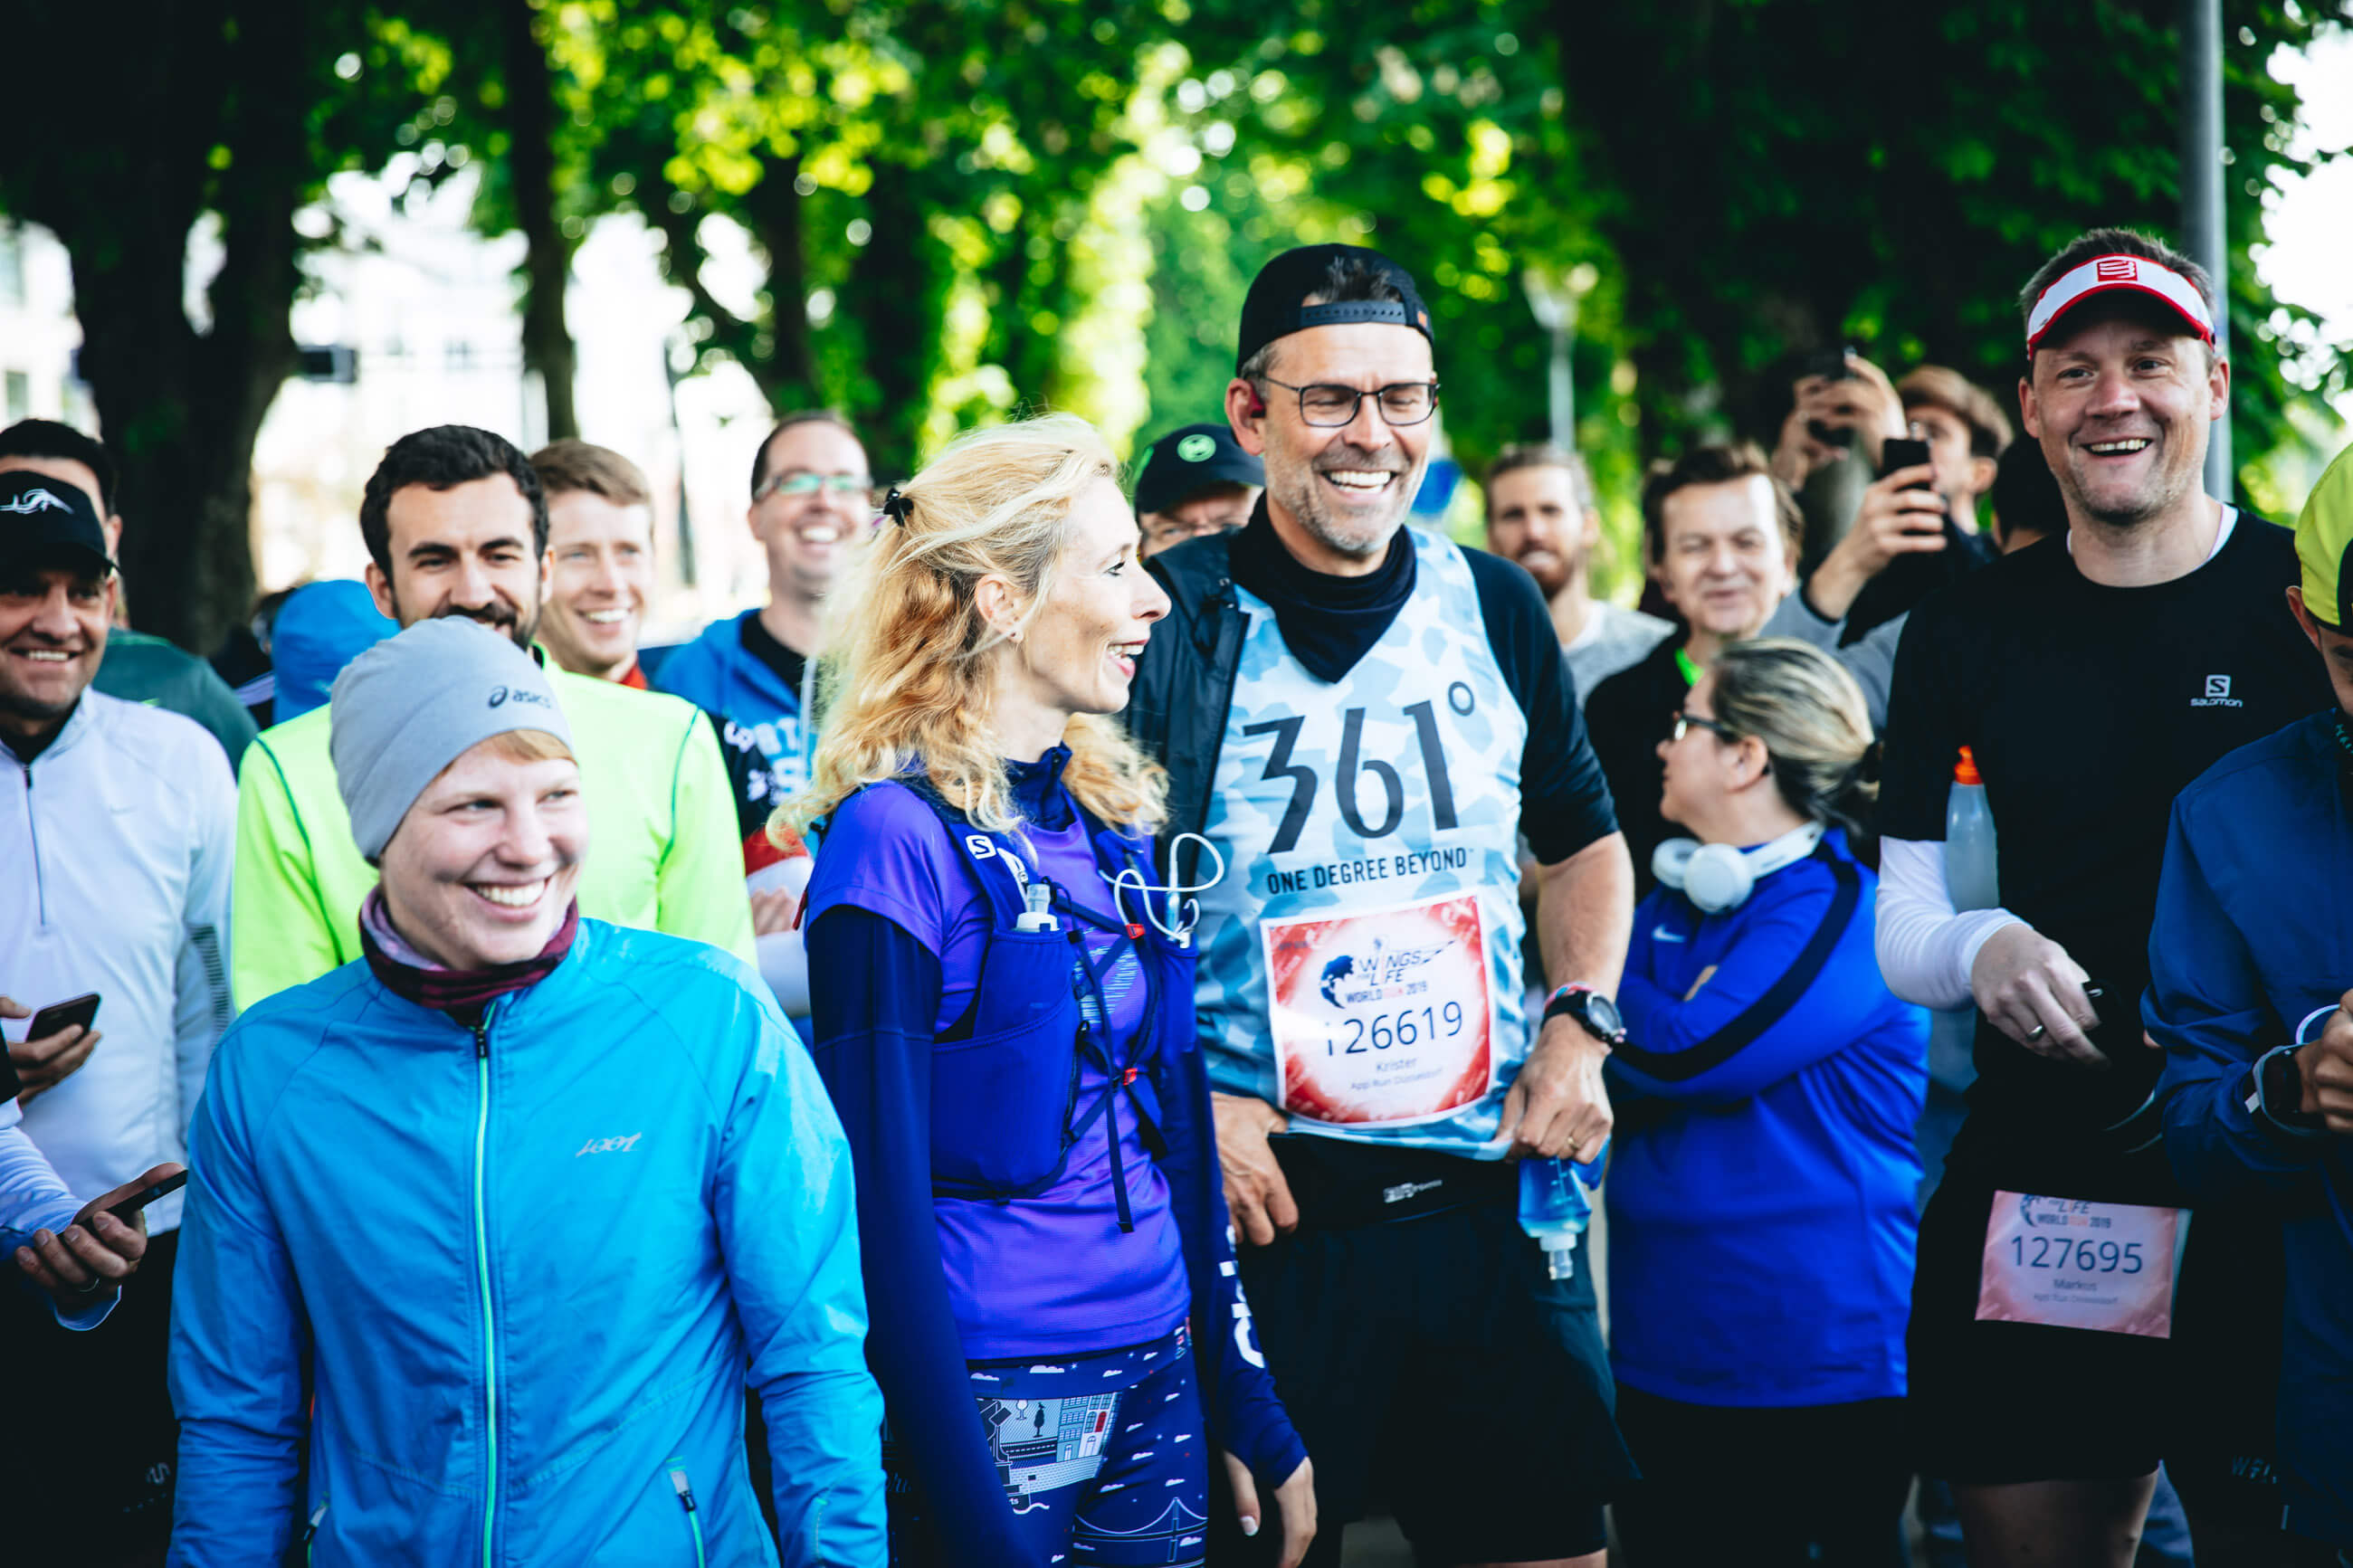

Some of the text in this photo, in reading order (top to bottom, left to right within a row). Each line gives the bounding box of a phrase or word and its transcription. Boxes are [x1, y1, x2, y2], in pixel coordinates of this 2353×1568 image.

[1268, 847, 1467, 894] ONE DEGREE BEYOND
[2011, 1235, 2143, 1274] 127695
